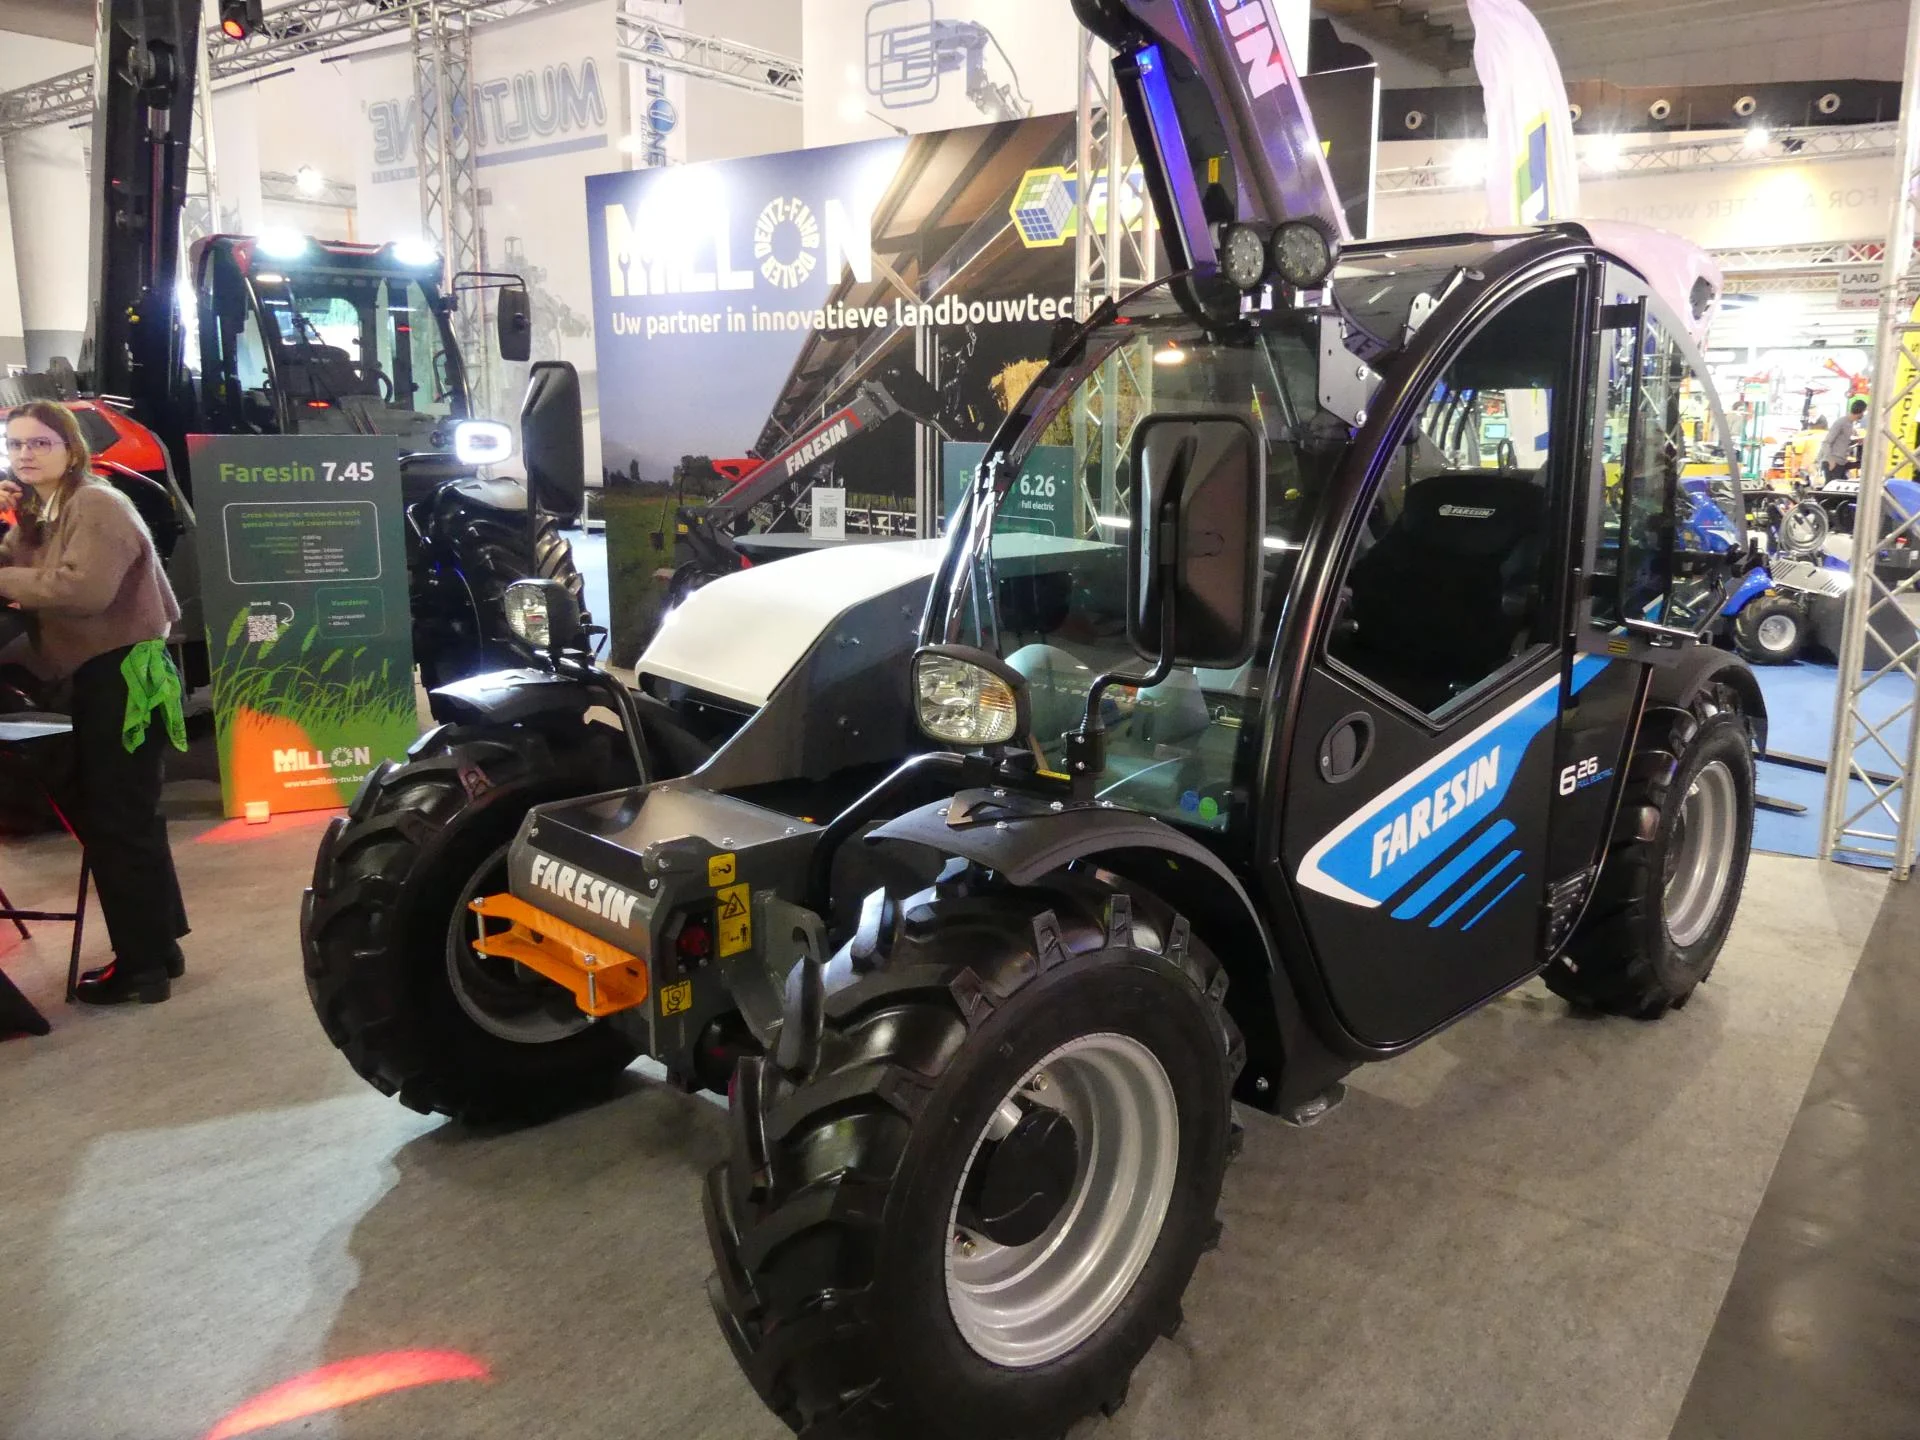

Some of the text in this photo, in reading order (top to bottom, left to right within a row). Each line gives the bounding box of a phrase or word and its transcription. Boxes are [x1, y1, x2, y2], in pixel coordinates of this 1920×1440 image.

[754, 196, 820, 259] DEUTZ-FAHR
[761, 251, 817, 290] DEALER
[612, 293, 1108, 339] Uw partner in innovatieve landbouwtec
[785, 419, 848, 477] FARESIN
[219, 461, 375, 483] Faresin 7.45
[1019, 474, 1056, 497] 6.26
[1021, 500, 1055, 511] full electric
[1370, 745, 1501, 879] FARESIN
[530, 854, 639, 929] FARESIN
